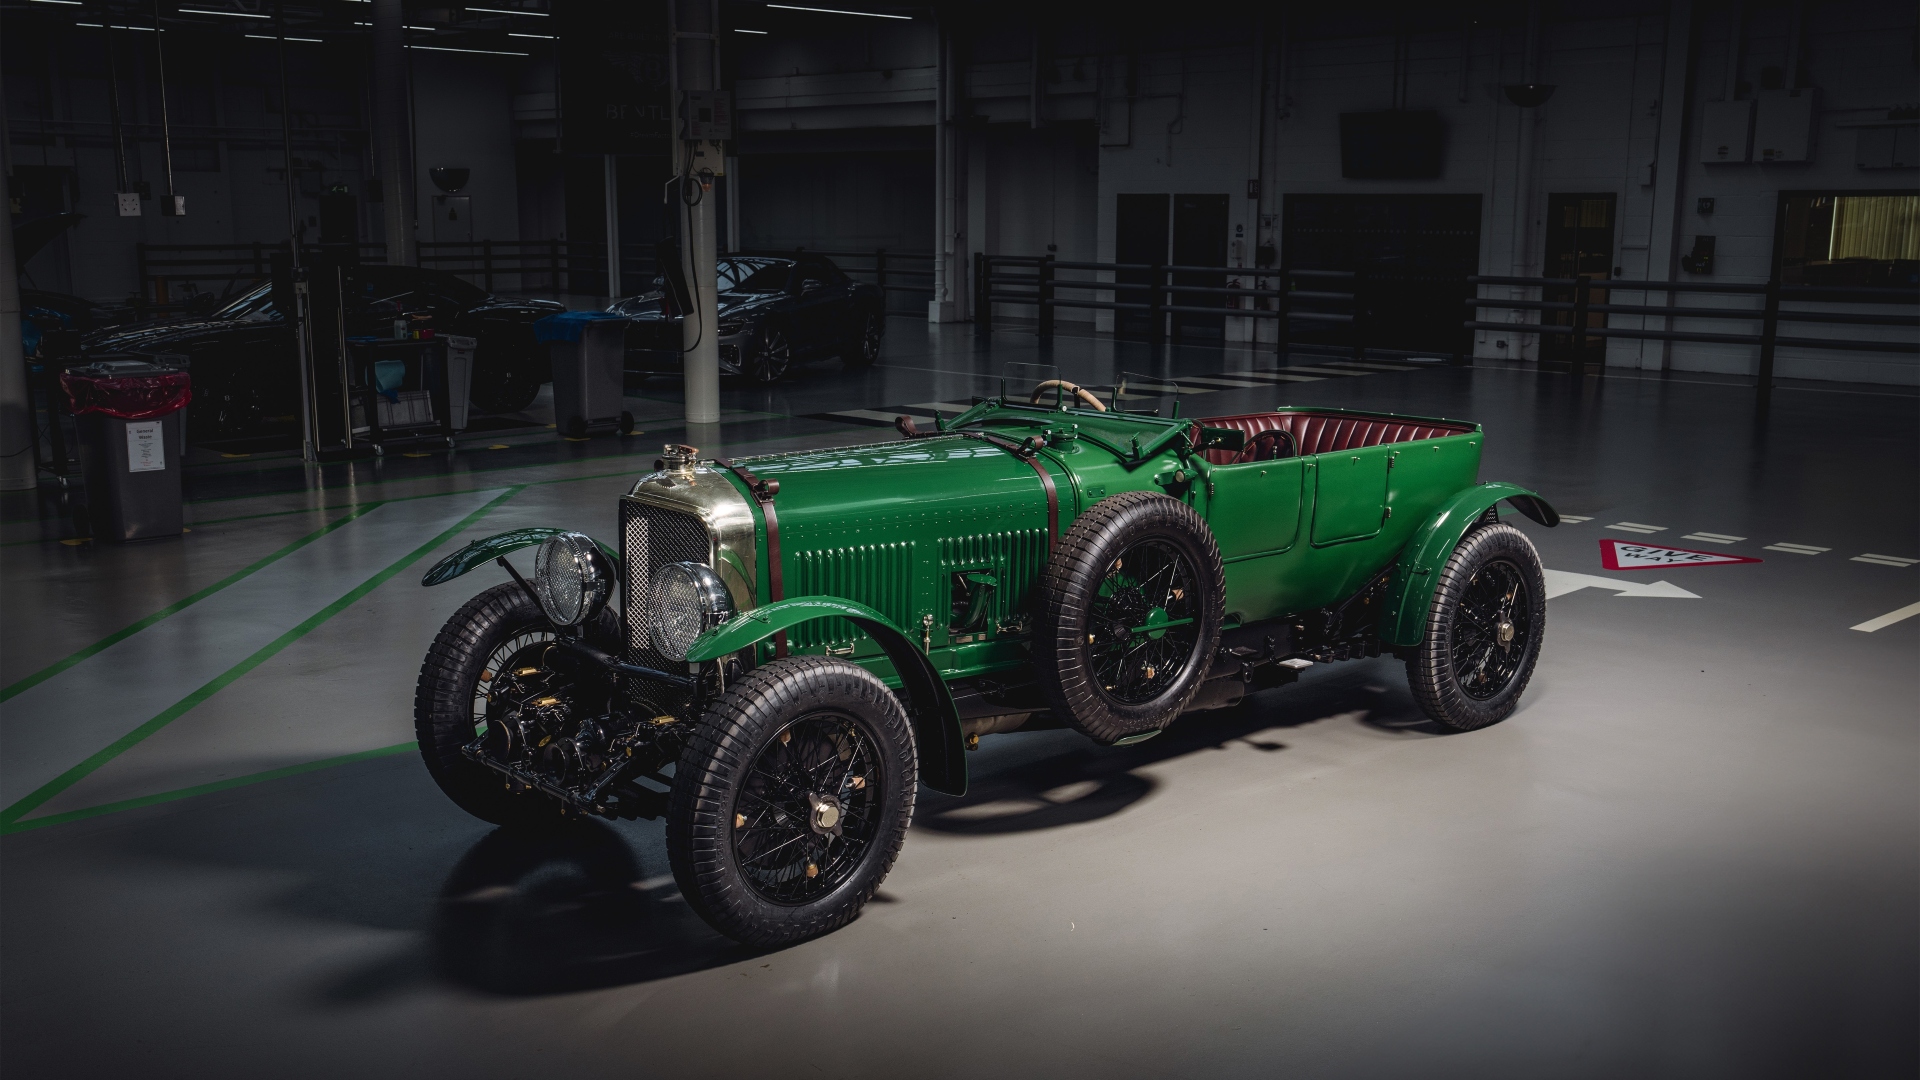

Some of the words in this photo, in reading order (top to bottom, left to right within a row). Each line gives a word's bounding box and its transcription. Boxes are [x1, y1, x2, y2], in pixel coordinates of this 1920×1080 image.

[606, 103, 671, 121] BENTL
[1620, 545, 1714, 562] GIVE
[1624, 552, 1684, 563] WAY
